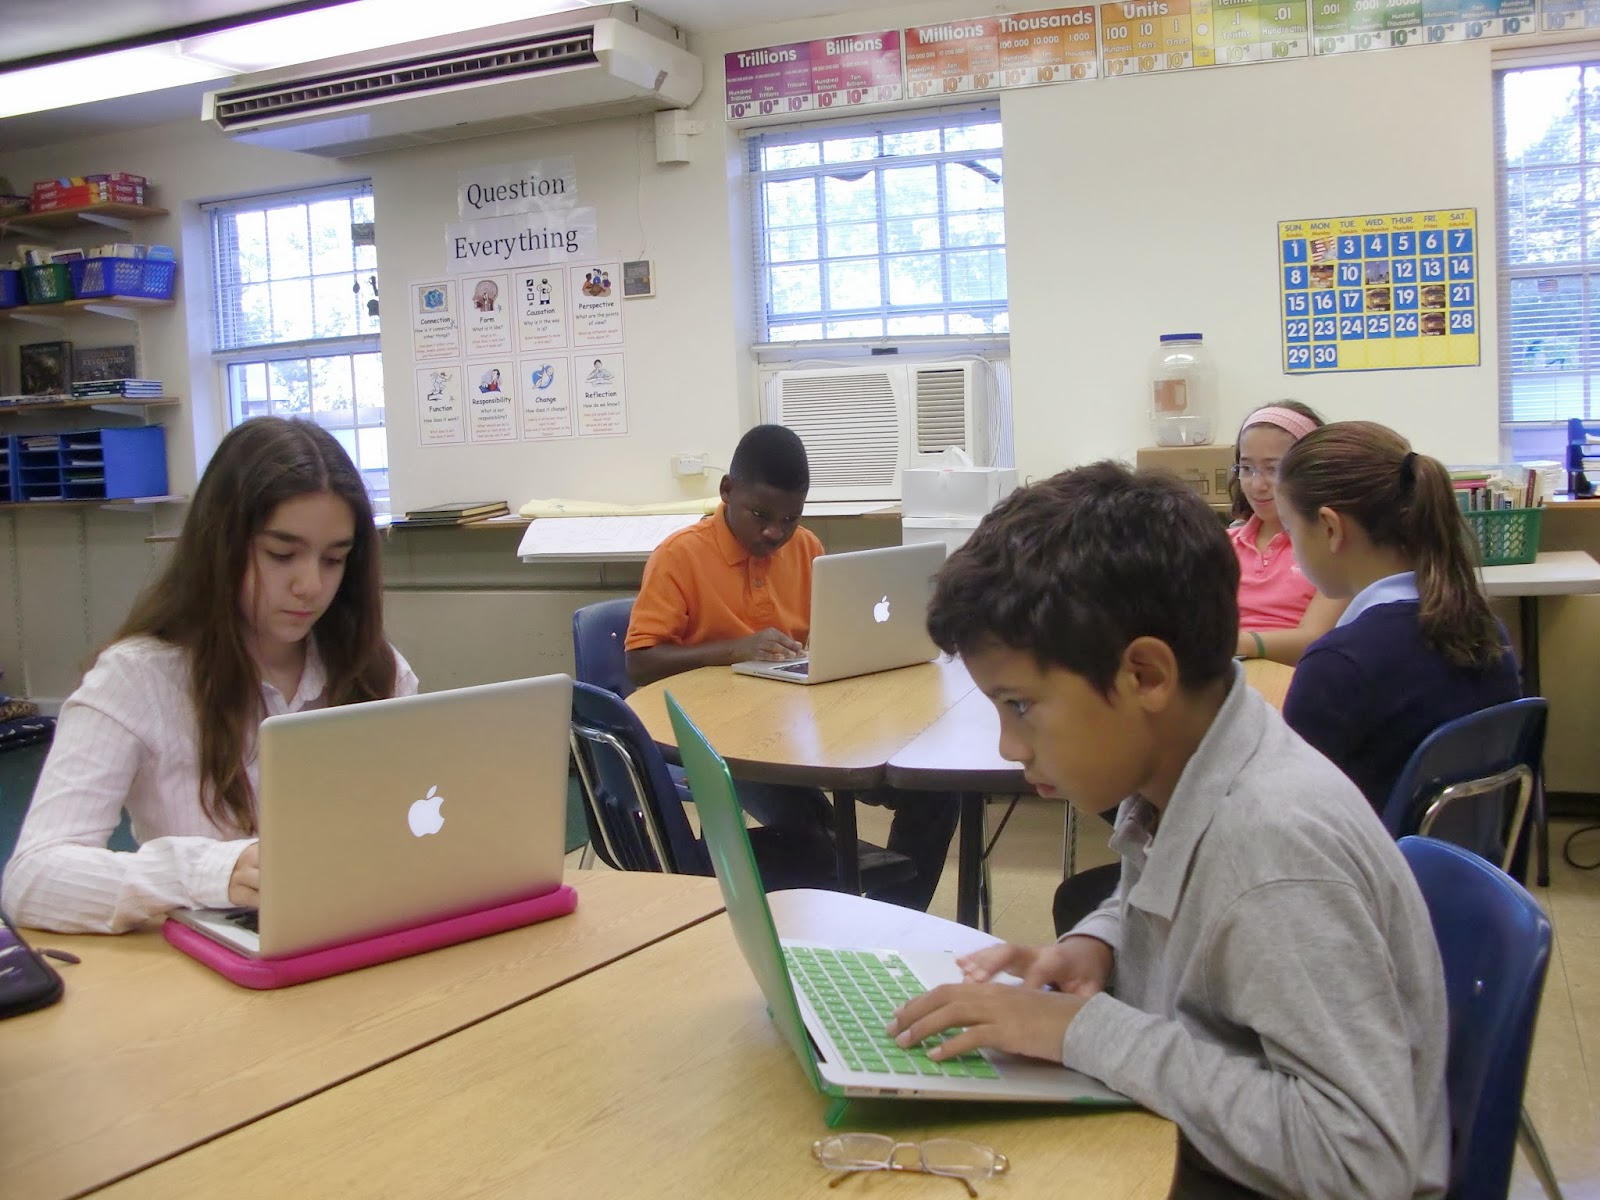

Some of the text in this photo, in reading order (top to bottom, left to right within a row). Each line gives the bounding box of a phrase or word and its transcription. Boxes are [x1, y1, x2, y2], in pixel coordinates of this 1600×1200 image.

[1123, 1, 1169, 19] Units
[1274, 6, 1291, 21] .01
[1320, 3, 1340, 16] .001
[999, 10, 1093, 33] Thousands
[1173, 19, 1179, 32] 1
[1232, 12, 1240, 25] .1
[918, 24, 984, 44] Millions
[1106, 25, 1128, 40] 100
[1140, 22, 1153, 36] 10
[1222, 30, 1251, 39] Tenths
[1262, 25, 1306, 35] Hundredths
[826, 38, 883, 56] Billions
[1104, 45, 1132, 53] Hundreds
[1138, 41, 1157, 50] Tens
[1166, 38, 1189, 46] Ones
[737, 49, 797, 68] Trillions
[467, 176, 566, 209] Question
[1285, 224, 1303, 232] SUN.
[1365, 218, 1385, 226] WED.
[1391, 216, 1415, 224] THUR.
[1423, 214, 1437, 222] FRI.
[454, 227, 579, 260] Everything
[1291, 233, 1465, 257] 1 3 4 5 6 7
[1290, 259, 1470, 284] 8 10 12 13 14
[578, 301, 614, 310] Perspective
[1288, 286, 1470, 311] 15 16 17 19 21
[526, 308, 555, 316] Causation
[420, 317, 450, 325] Connection
[1287, 313, 1473, 338] 22 23 24 25 26 28
[1288, 347, 1336, 364] 29 30
[472, 396, 511, 406] Responsibility
[584, 391, 617, 399] Reflection
